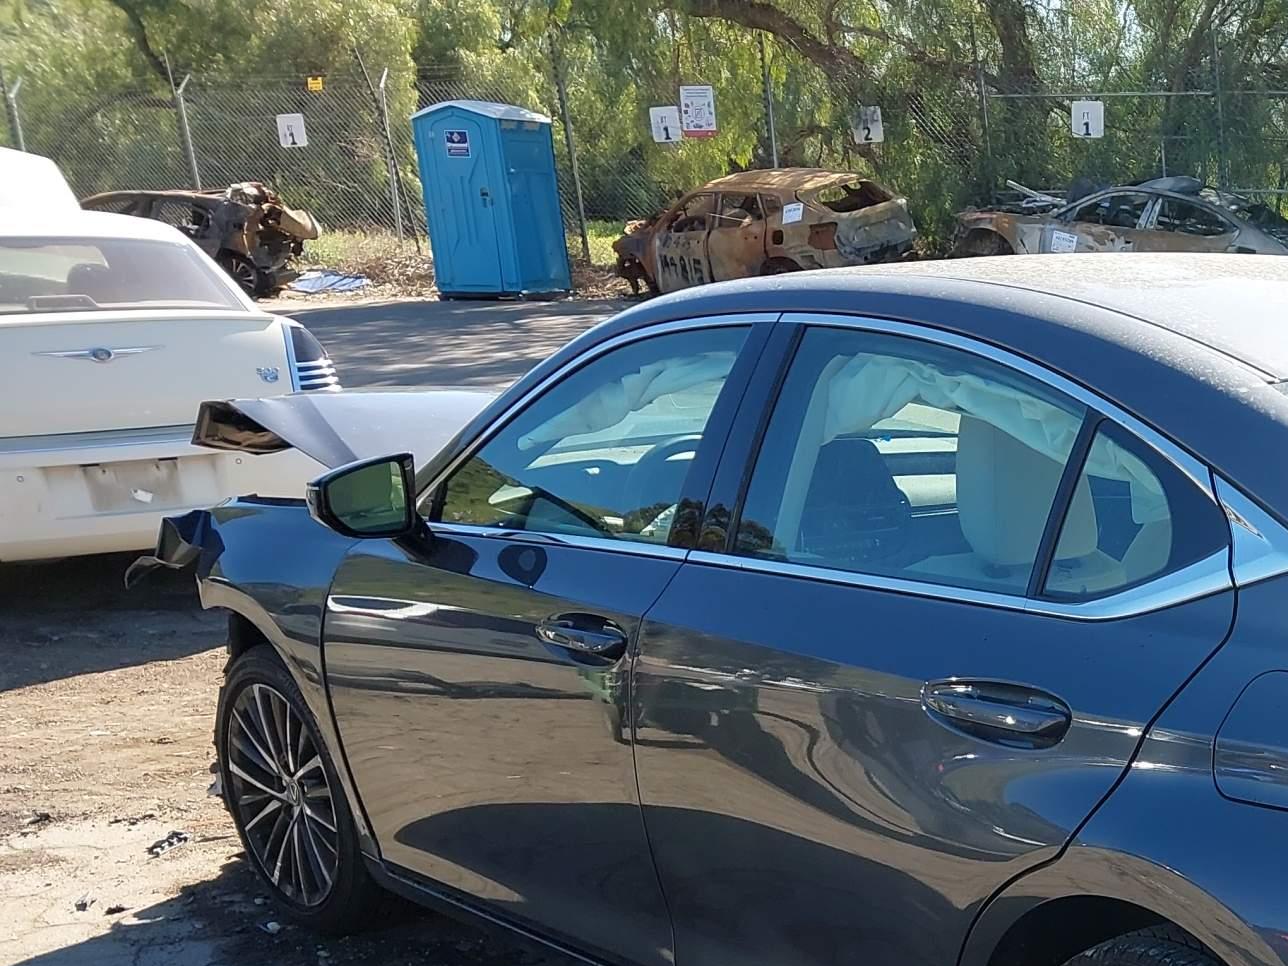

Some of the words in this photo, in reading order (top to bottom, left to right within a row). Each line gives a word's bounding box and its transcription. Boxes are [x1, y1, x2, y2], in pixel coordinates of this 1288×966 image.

[663, 126, 672, 141] 1
[863, 127, 873, 141] 2
[1083, 121, 1092, 136] 1
